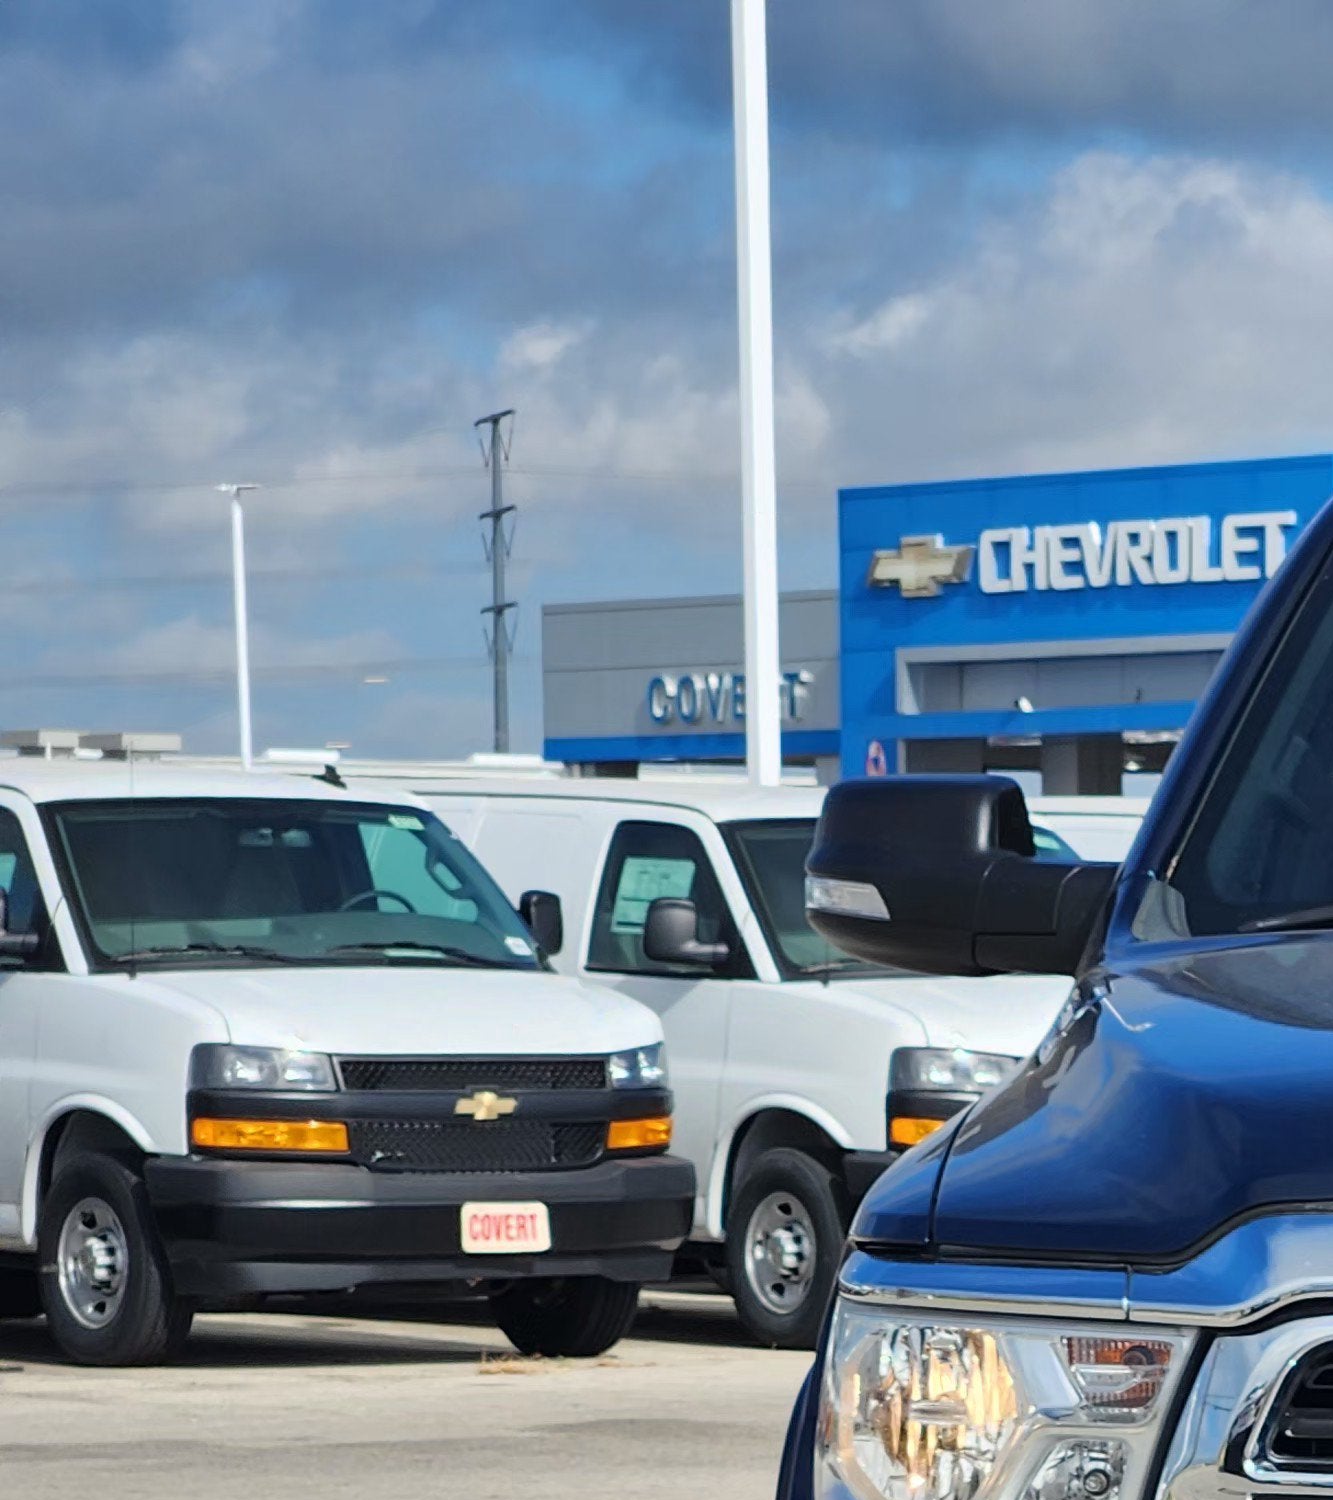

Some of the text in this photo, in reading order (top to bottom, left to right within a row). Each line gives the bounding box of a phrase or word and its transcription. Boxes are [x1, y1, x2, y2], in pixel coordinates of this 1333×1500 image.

[979, 510, 1297, 594] CHEVROLET
[648, 672, 813, 724] COVET
[469, 1213, 537, 1241] COVERT
